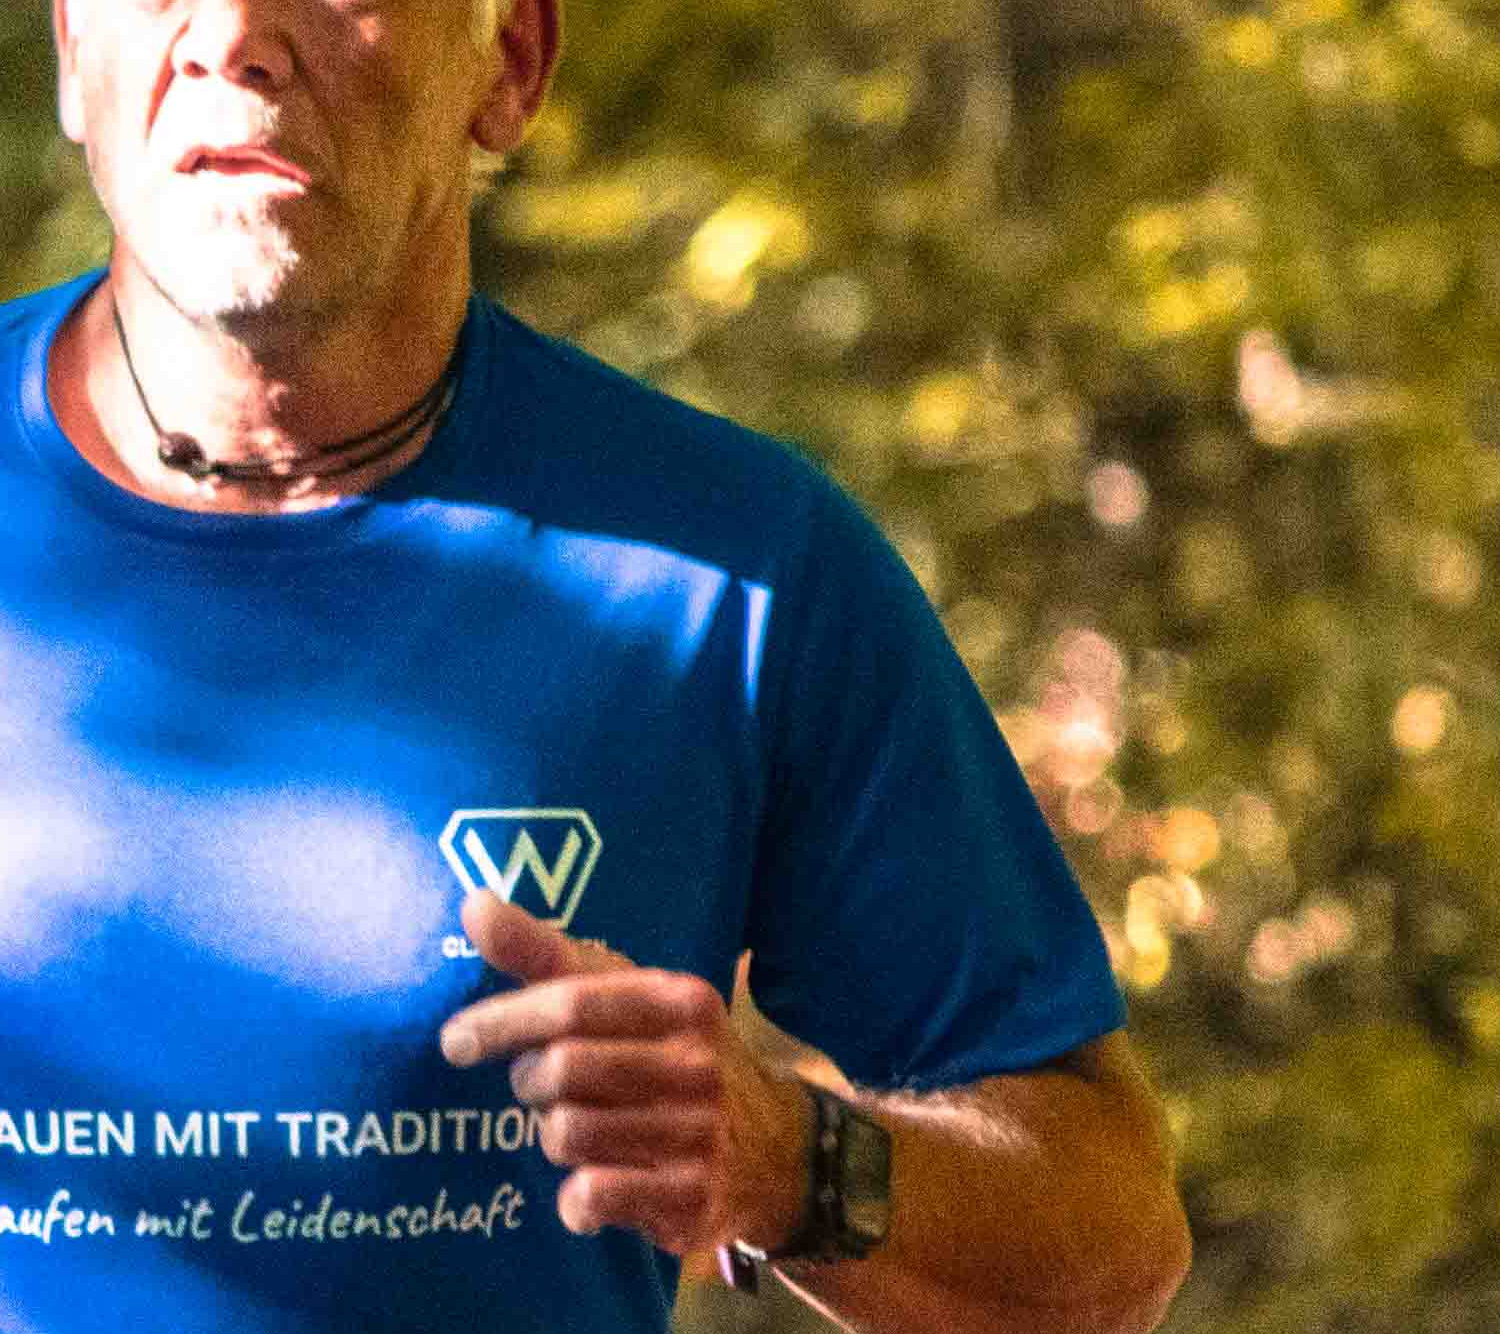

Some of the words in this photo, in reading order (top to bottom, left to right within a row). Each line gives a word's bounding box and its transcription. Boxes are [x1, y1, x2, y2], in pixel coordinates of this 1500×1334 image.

[154, 1110, 260, 1158] MIT
[134, 1197, 216, 1240] mit
[231, 1182, 524, 1243] Leidenschaft
